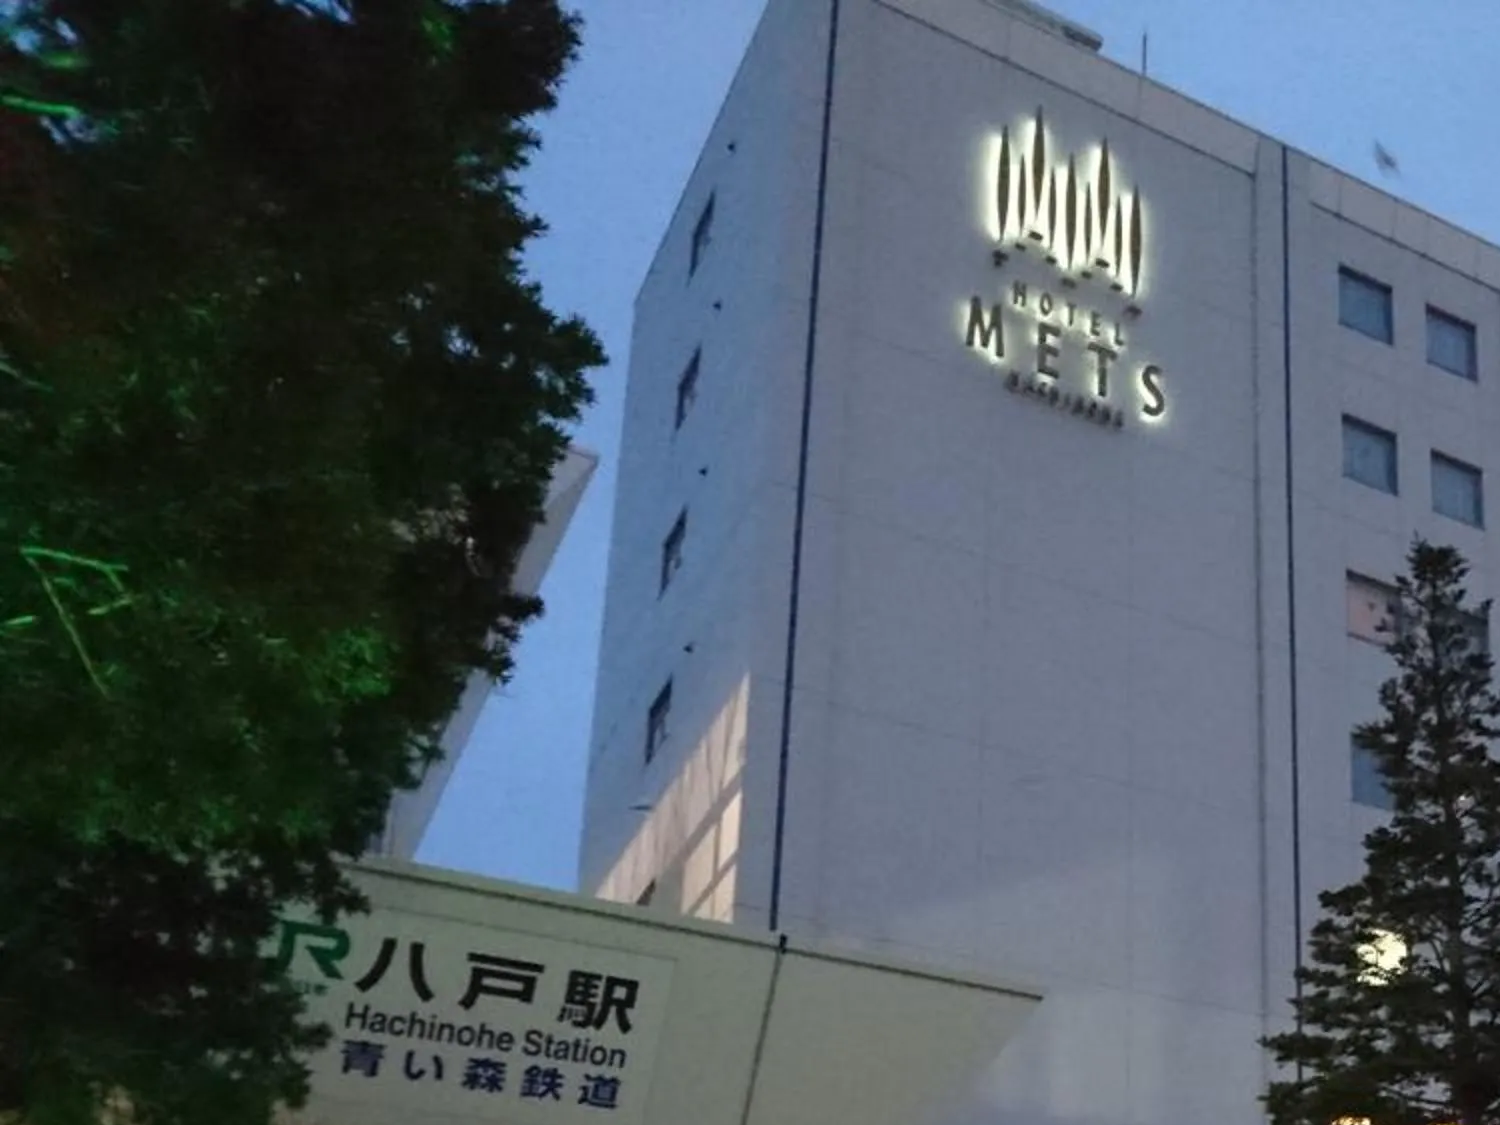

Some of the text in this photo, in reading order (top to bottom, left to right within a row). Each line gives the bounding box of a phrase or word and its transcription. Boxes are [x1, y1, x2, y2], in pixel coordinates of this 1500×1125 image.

[1013, 280, 1123, 346] HOTEL
[966, 296, 1165, 416] METS
[354, 937, 641, 1035] 八戸駅
[345, 1002, 627, 1069] Hachinohe Station
[341, 1039, 622, 1110] 青い森鉄道
